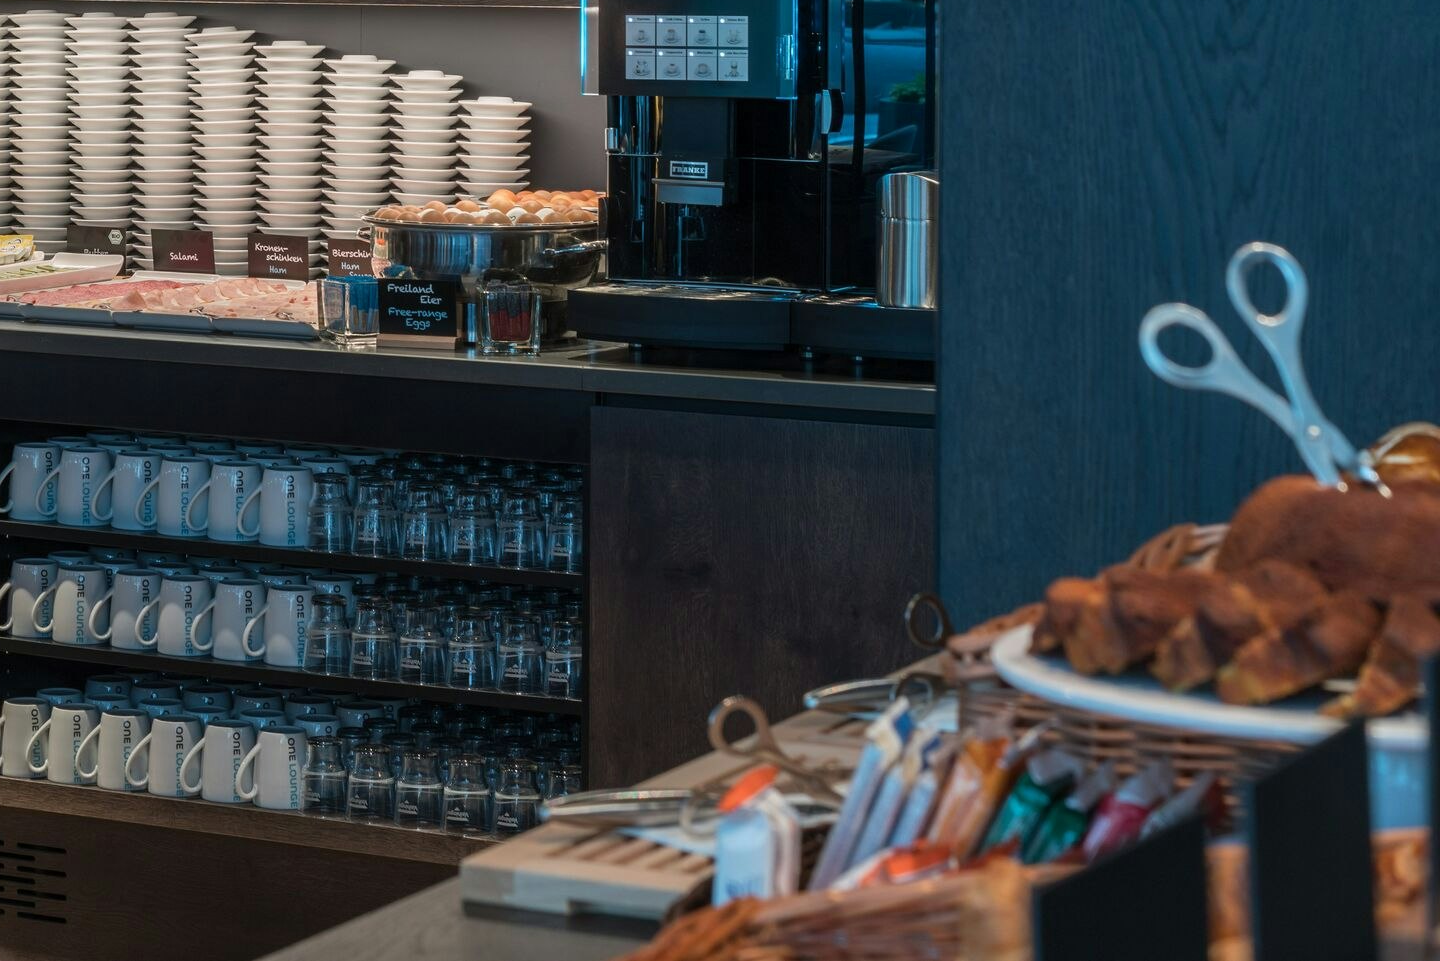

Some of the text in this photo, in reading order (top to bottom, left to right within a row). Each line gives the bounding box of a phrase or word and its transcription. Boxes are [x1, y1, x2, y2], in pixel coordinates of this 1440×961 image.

[255, 242, 289, 252] Kronen-
[169, 252, 199, 261] Salami
[266, 253, 304, 263] schinken
[332, 248, 371, 258] Bierschin
[269, 266, 287, 274] Ham
[341, 261, 360, 270] Ham
[387, 283, 434, 294] Freiland
[420, 295, 442, 304] Eier
[388, 307, 448, 320] Free-range
[405, 318, 431, 330] Eggs
[73, 714, 81, 737] ONE
[123, 720, 132, 744] ONE
[175, 726, 184, 750] ONE
[232, 731, 241, 755] ONE
[287, 737, 298, 808] ONE LOUNGE
